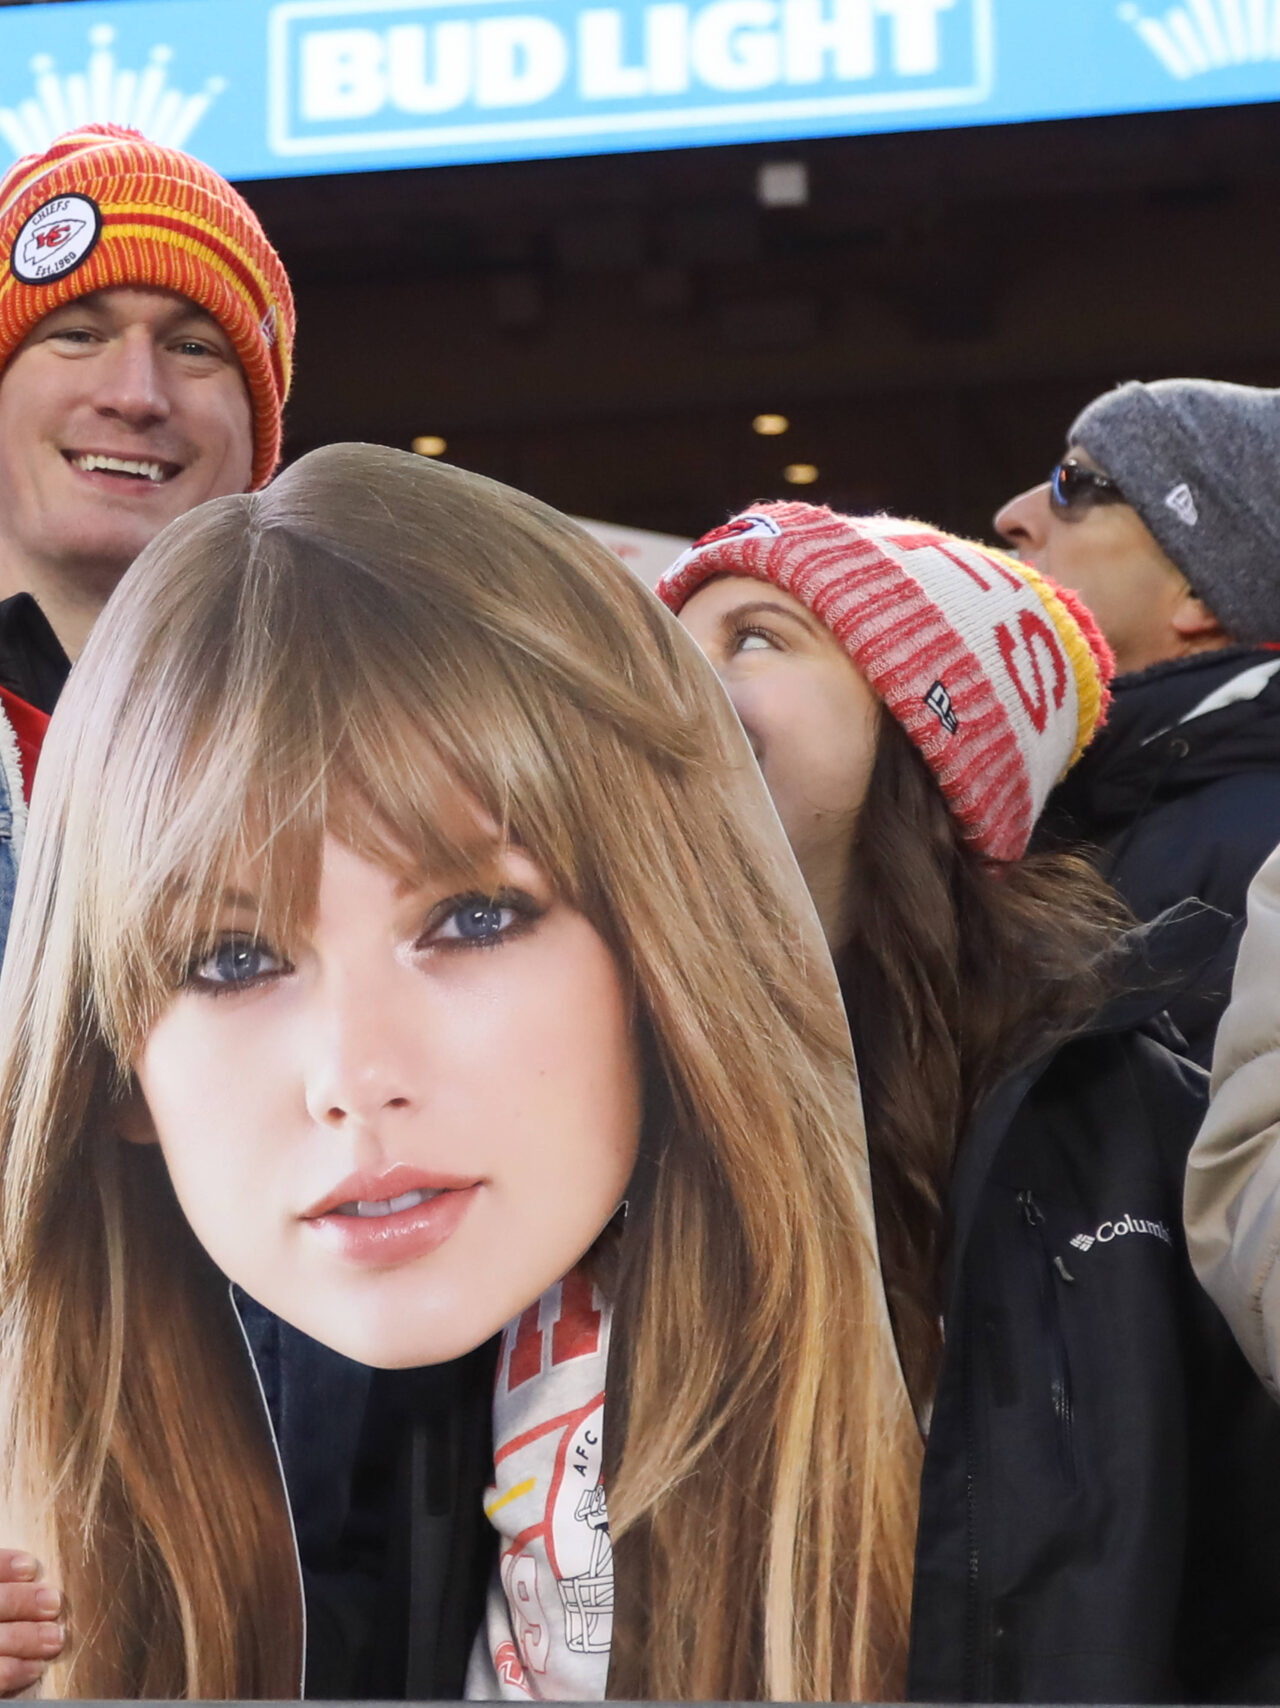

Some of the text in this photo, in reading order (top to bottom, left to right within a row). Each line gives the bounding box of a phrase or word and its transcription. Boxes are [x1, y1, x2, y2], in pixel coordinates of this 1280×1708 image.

[300, 0, 956, 123] BUD LIGHT
[31, 200, 71, 226] CHIEFS
[1096, 1213, 1172, 1242] Columb
[573, 1430, 598, 1477] AFC
